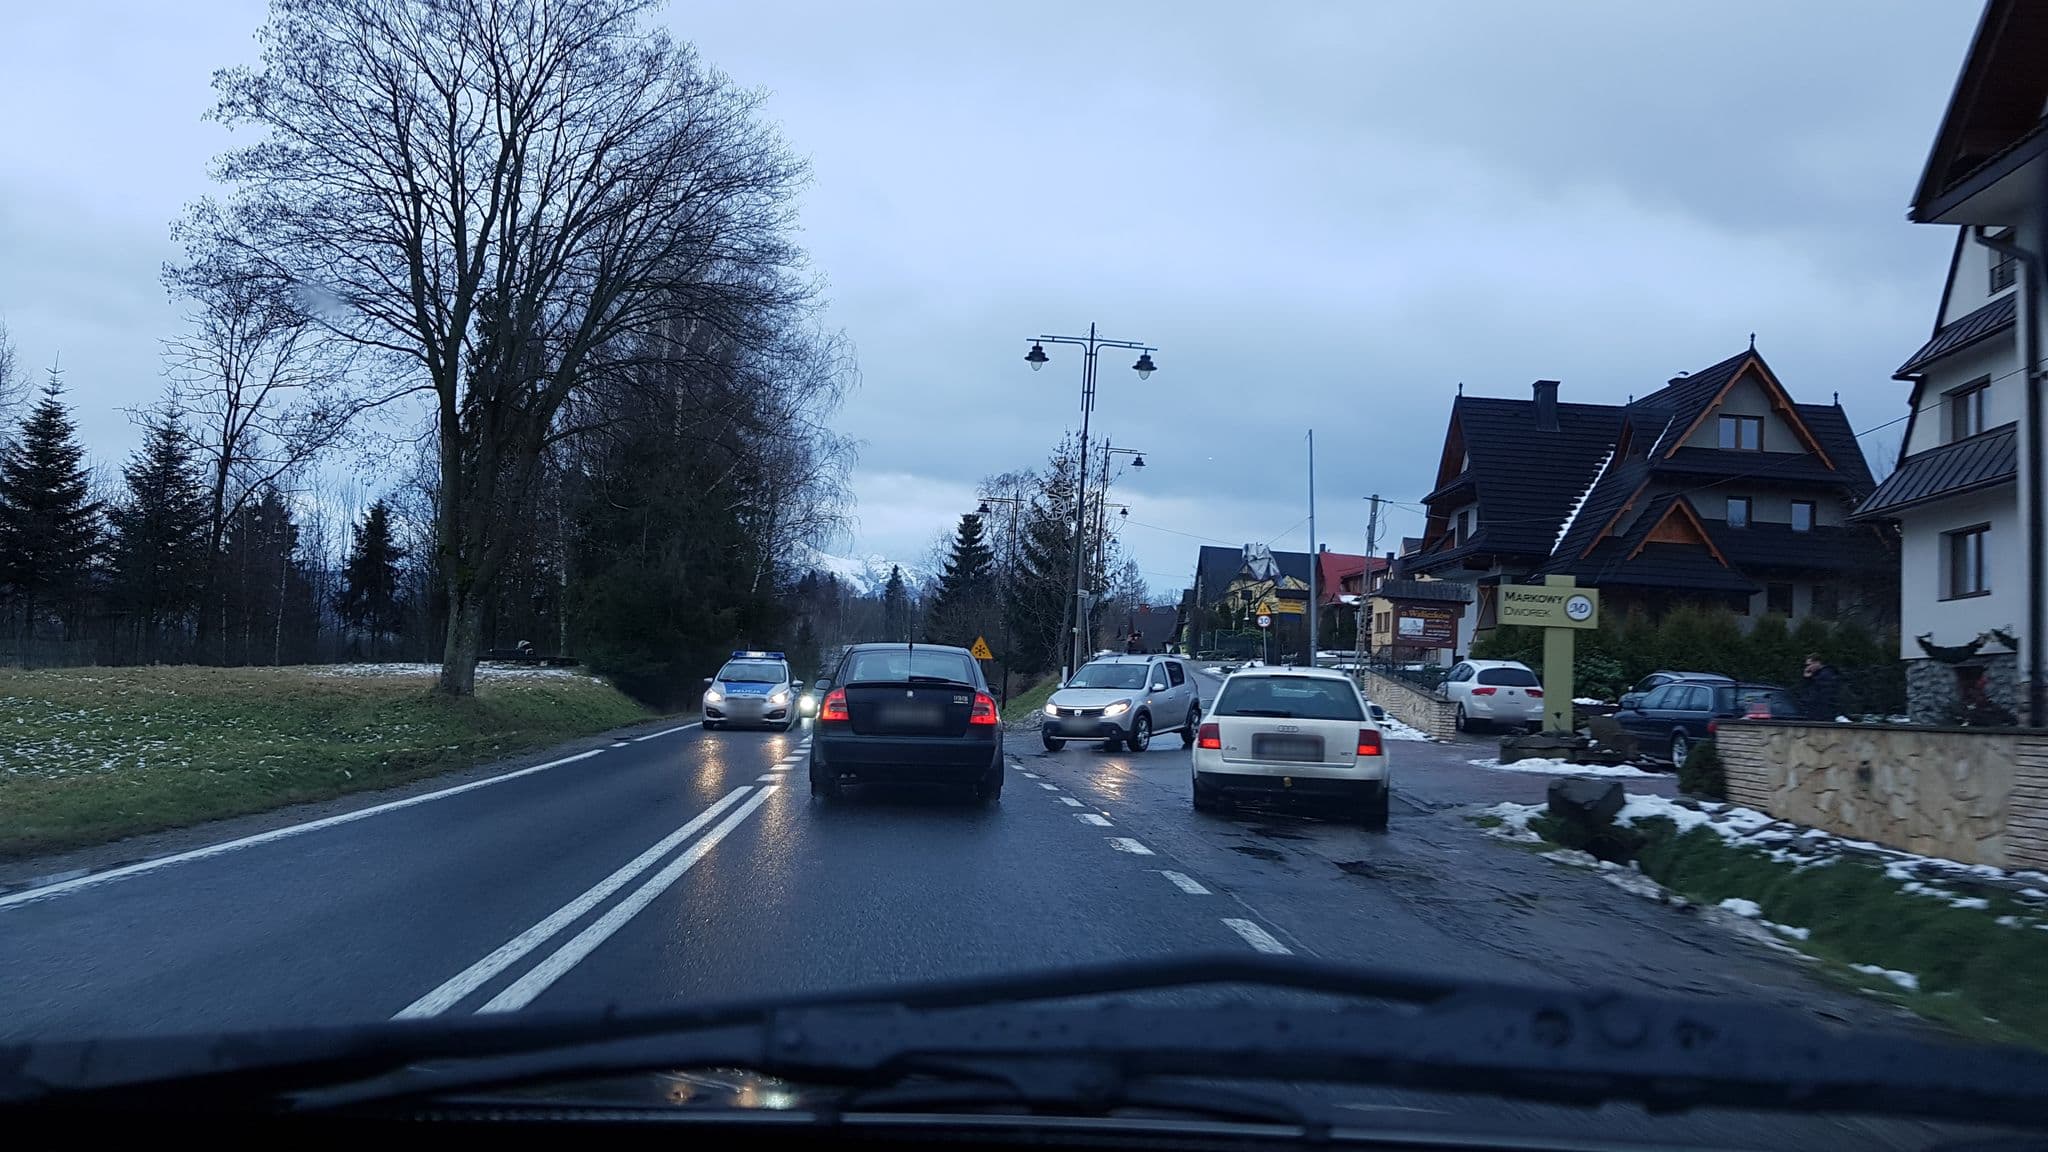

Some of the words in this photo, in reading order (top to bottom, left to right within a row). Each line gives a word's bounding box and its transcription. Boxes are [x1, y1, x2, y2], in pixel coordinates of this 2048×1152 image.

[1504, 591, 1564, 604] MARKOWY
[1503, 606, 1552, 617] DWOREK
[1260, 617, 1269, 625] 30
